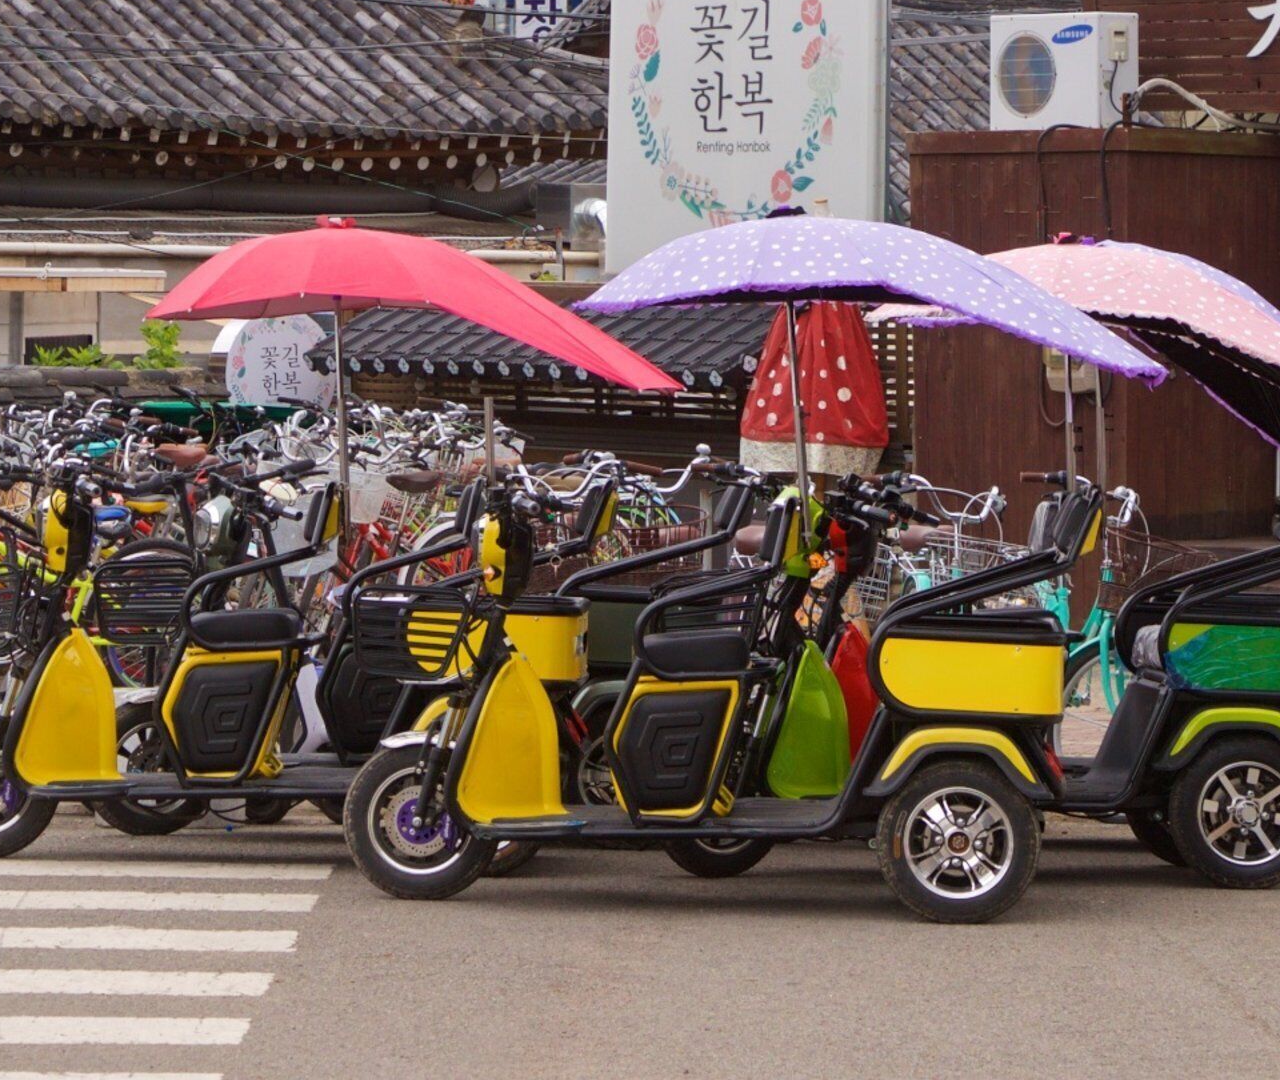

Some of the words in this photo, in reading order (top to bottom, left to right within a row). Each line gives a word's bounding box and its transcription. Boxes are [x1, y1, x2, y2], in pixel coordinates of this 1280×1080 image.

[1056, 29, 1089, 40] SAMSUNG
[690, 70, 774, 135] 한복
[696, 140, 734, 156] Renting
[736, 140, 771, 153] Hanbok
[260, 342, 301, 369] 꽃길
[261, 370, 302, 397] 한복
